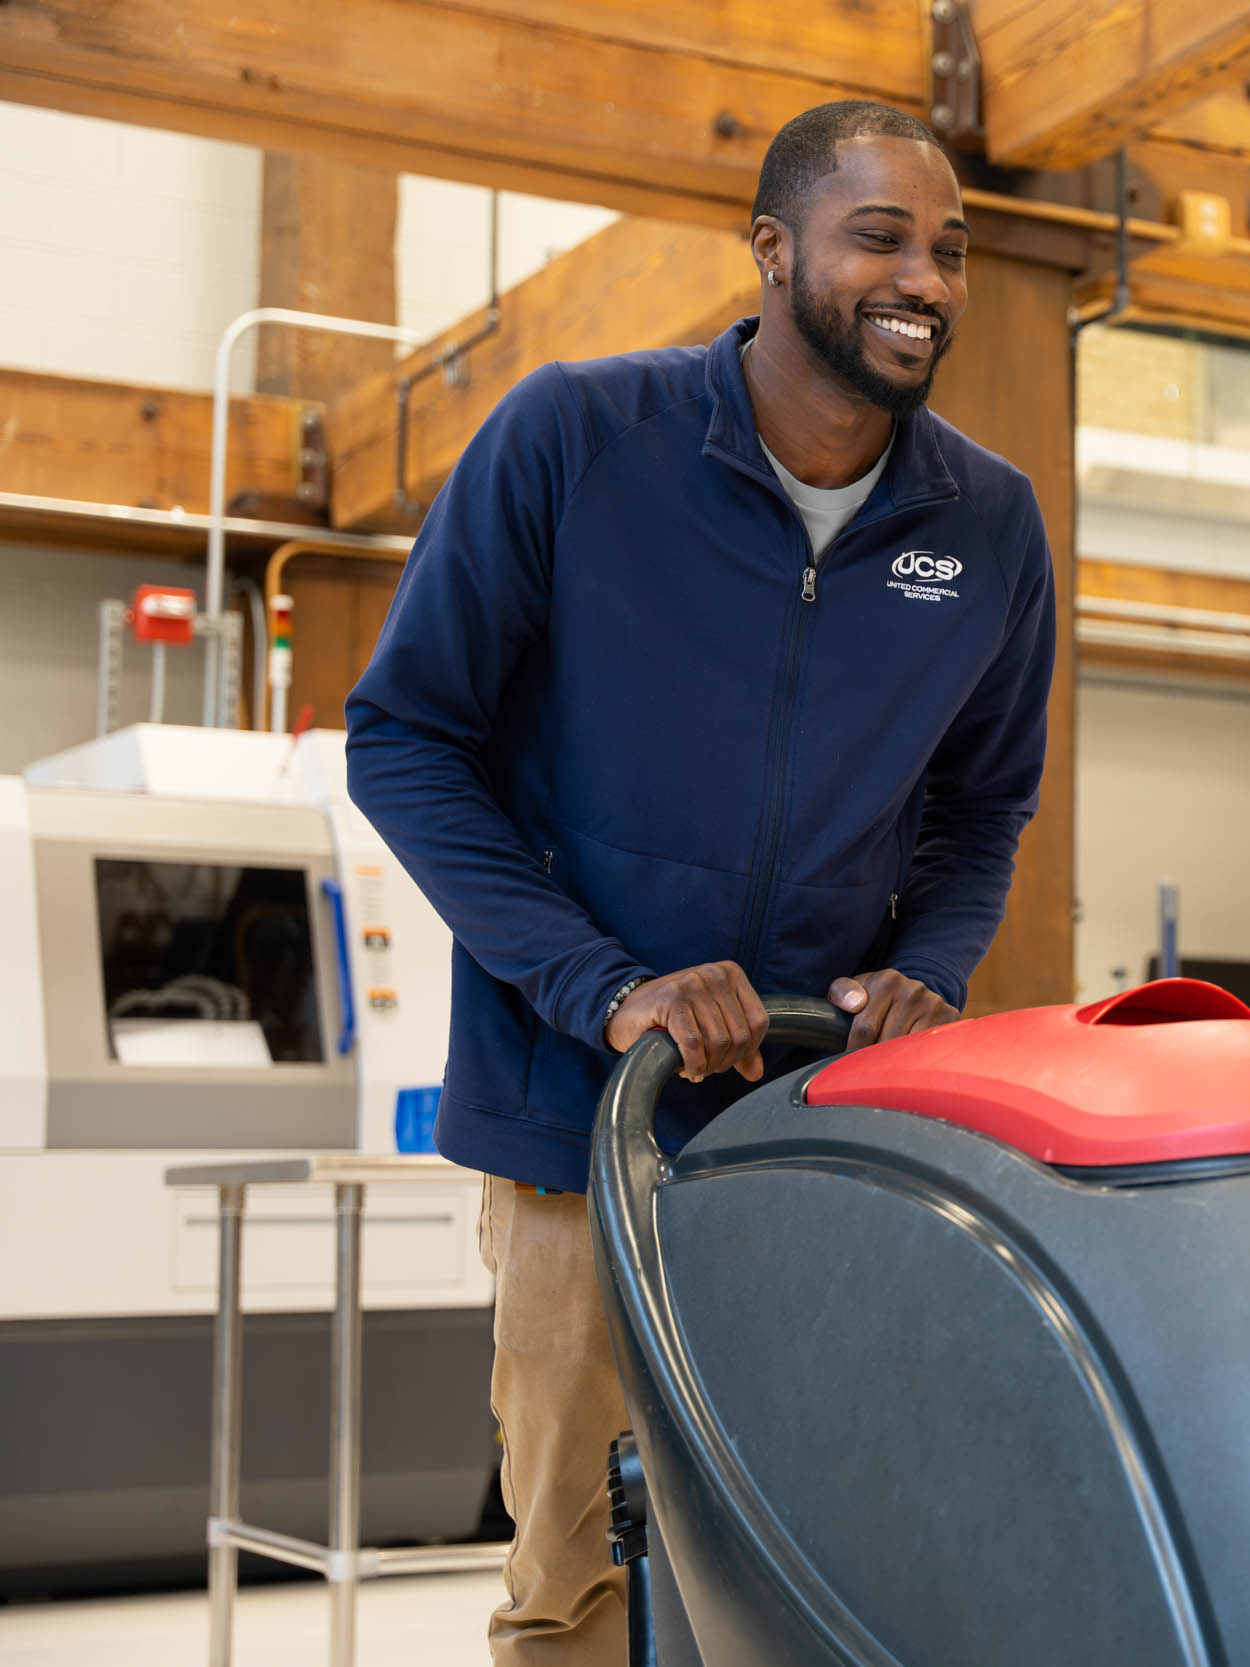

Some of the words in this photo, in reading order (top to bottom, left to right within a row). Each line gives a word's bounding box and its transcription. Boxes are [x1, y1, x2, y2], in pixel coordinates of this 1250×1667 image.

[897, 552, 955, 581] UCS
[886, 580, 911, 591] UNITED
[911, 585, 960, 598] COMMERCIAL
[904, 591, 941, 602] SERVICES
